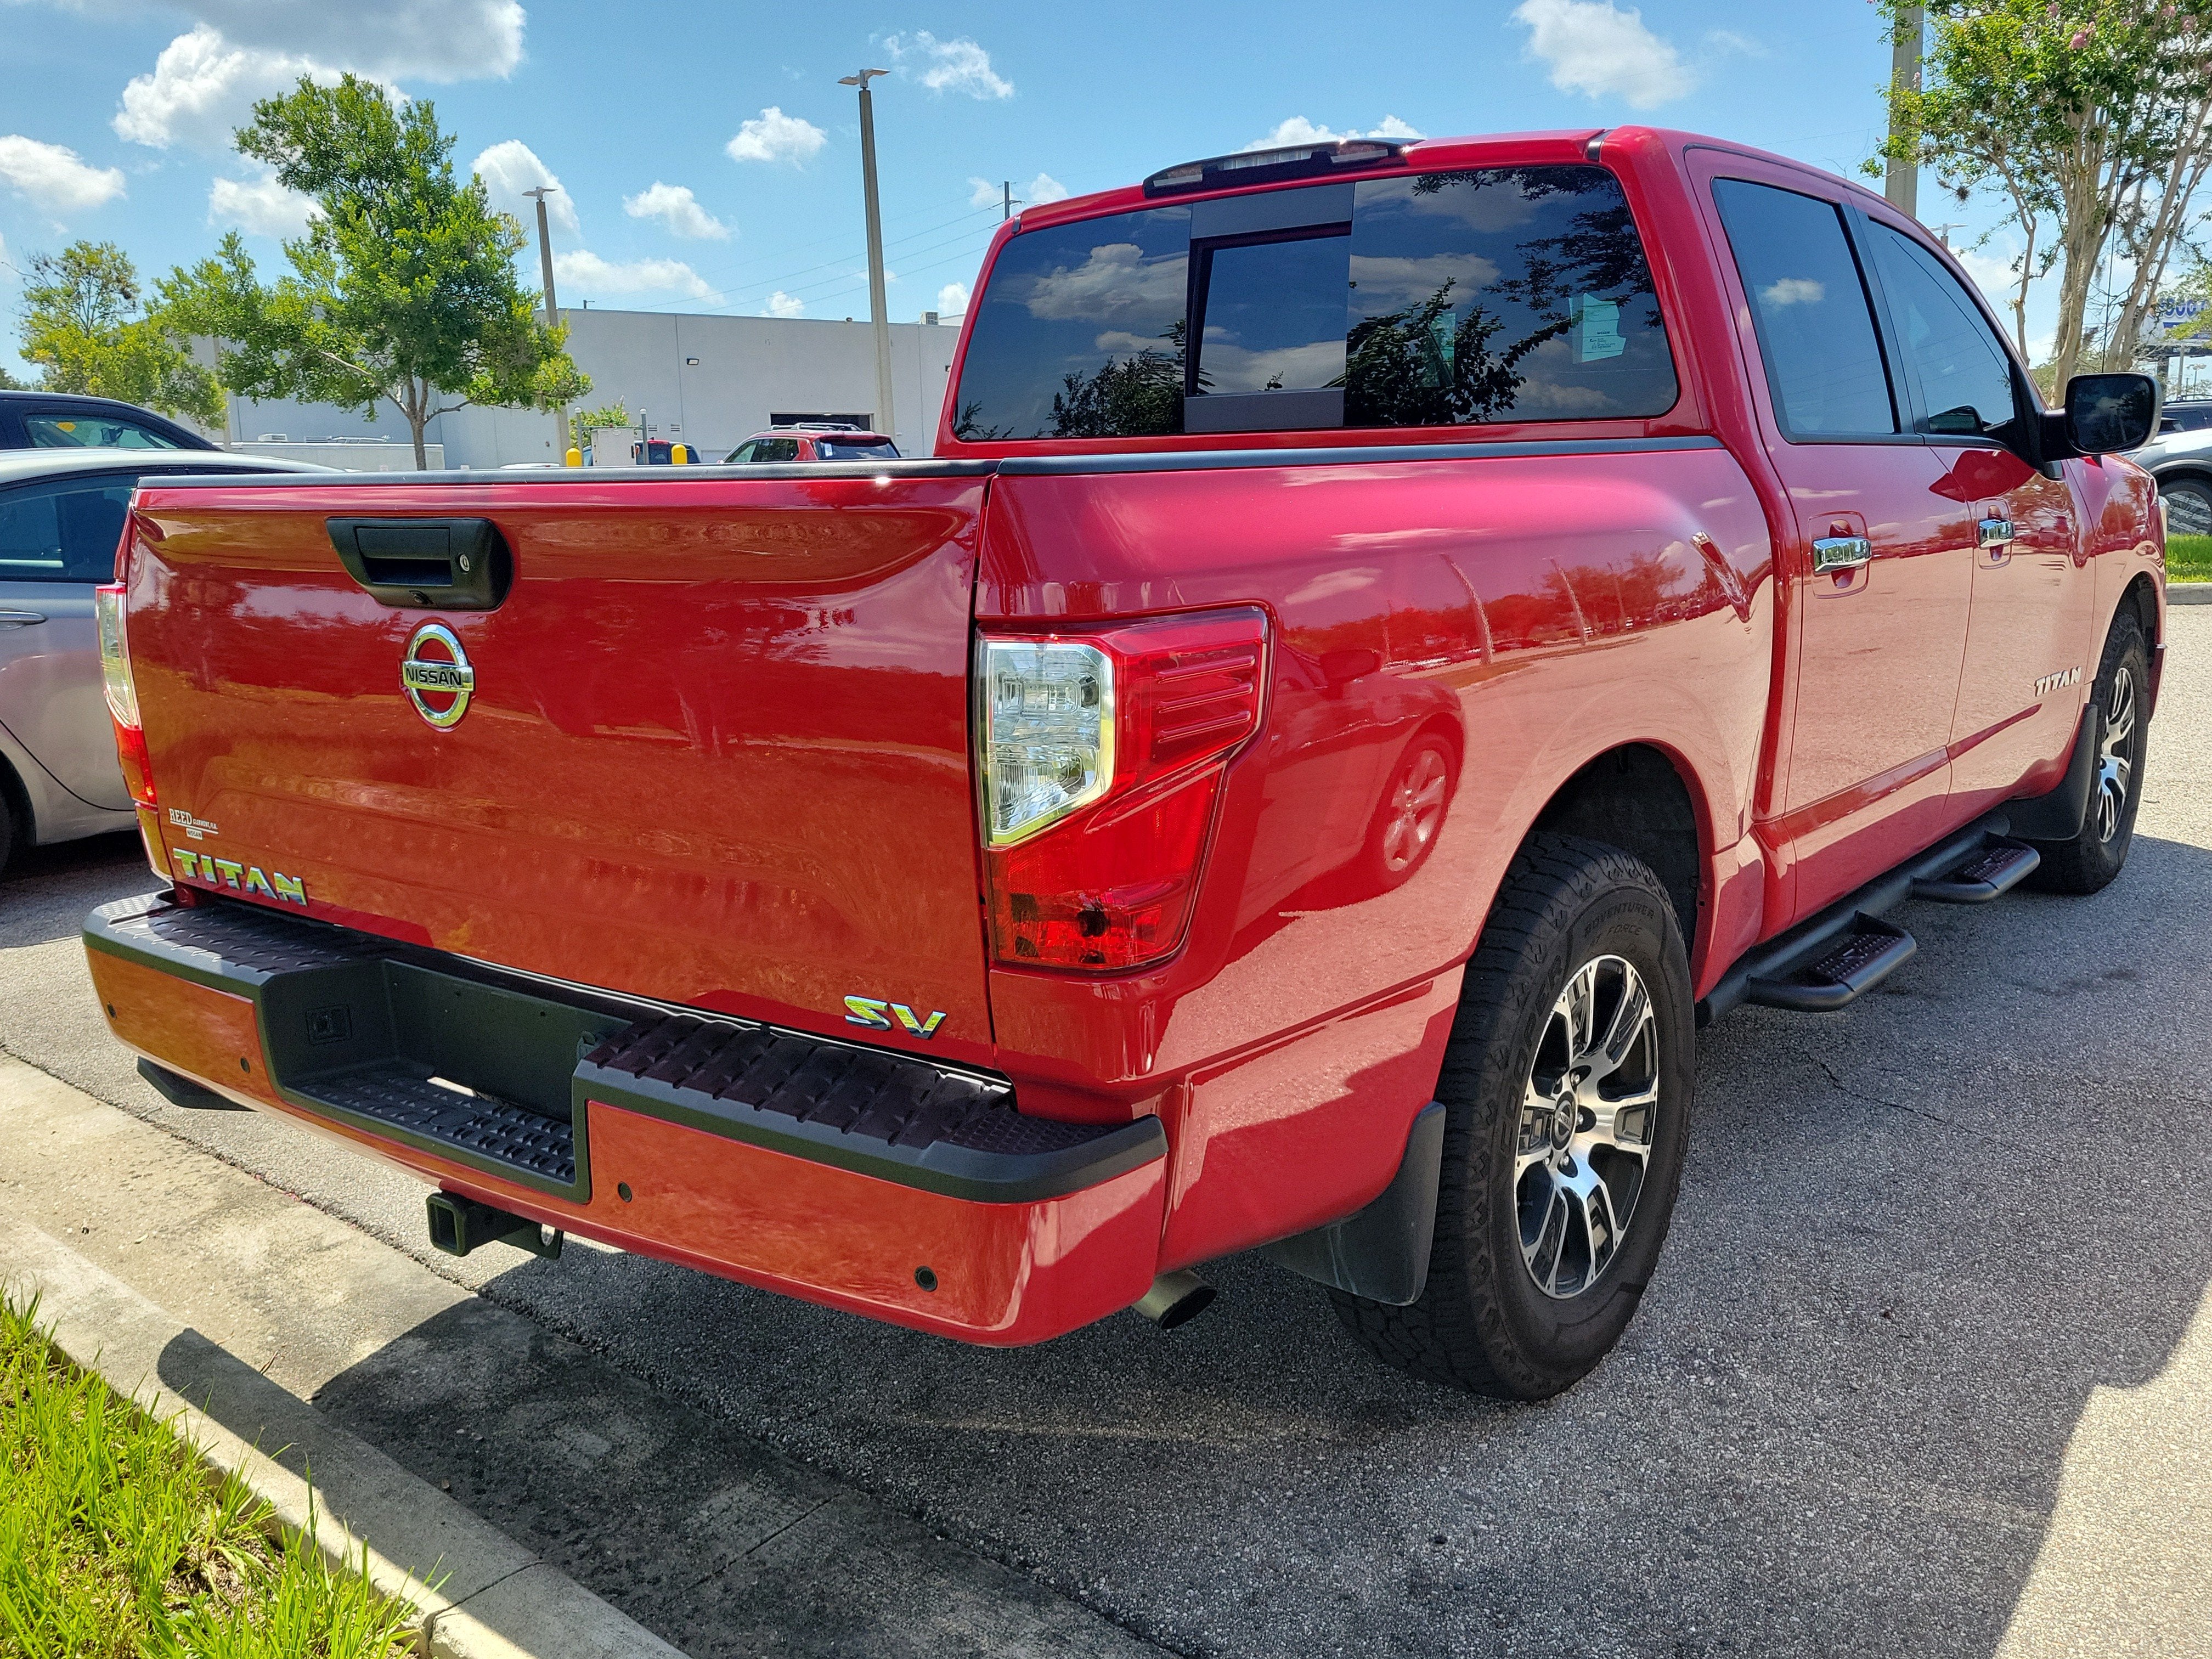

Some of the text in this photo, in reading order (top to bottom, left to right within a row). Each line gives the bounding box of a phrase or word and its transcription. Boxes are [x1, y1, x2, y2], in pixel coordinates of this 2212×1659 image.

[405, 667, 462, 686] NISSAN
[2034, 665, 2081, 697] TITAN
[168, 808, 192, 825] REED
[173, 847, 308, 907] TITAN
[843, 995, 948, 1040] SV
